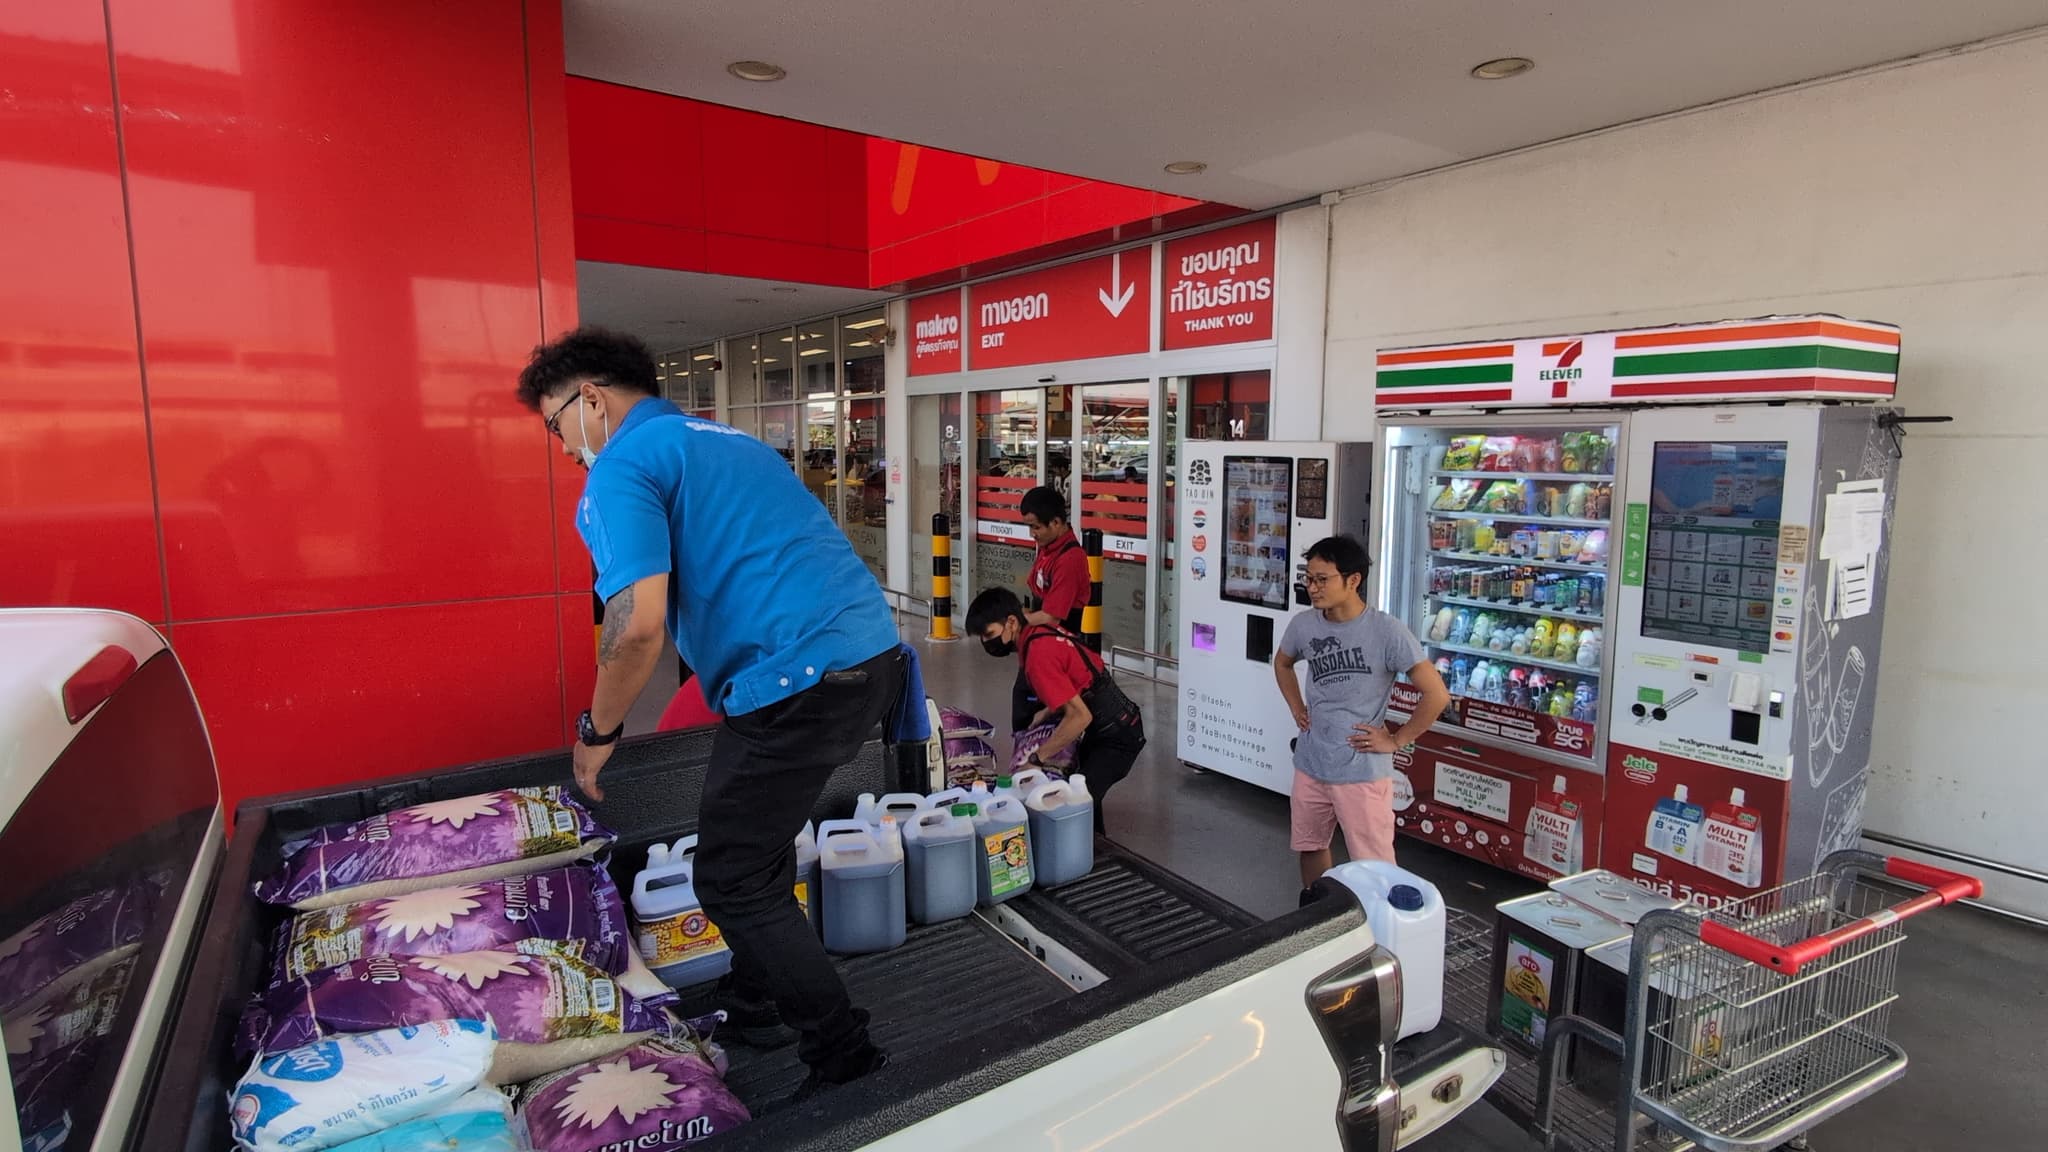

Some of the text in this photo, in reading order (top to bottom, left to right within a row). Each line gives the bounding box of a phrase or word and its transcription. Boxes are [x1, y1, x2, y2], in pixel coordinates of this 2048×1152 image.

[1181, 241, 1260, 276] ขอบคุณ
[1170, 277, 1271, 313] ที่ใช้บริการ
[981, 292, 1049, 328] ทางออก
[916, 313, 958, 339] makro
[1184, 311, 1254, 332] THANK YOU
[981, 332, 1005, 349] EXIT
[945, 424, 954, 438] 8
[1229, 418, 1245, 438] 14
[1116, 540, 1135, 551] EXIT
[1557, 721, 1583, 736] true
[1554, 732, 1583, 750] 5G
[1623, 756, 1657, 773] Jele
[1456, 786, 1473, 798] PULL
[1476, 791, 1487, 801] UP
[1706, 833, 1746, 851] VITAMIN
[1708, 823, 1748, 844] MULTI
[1521, 958, 1537, 970] aro
[323, 1110, 358, 1129] ขนาด
[358, 1103, 367, 1114] 5
